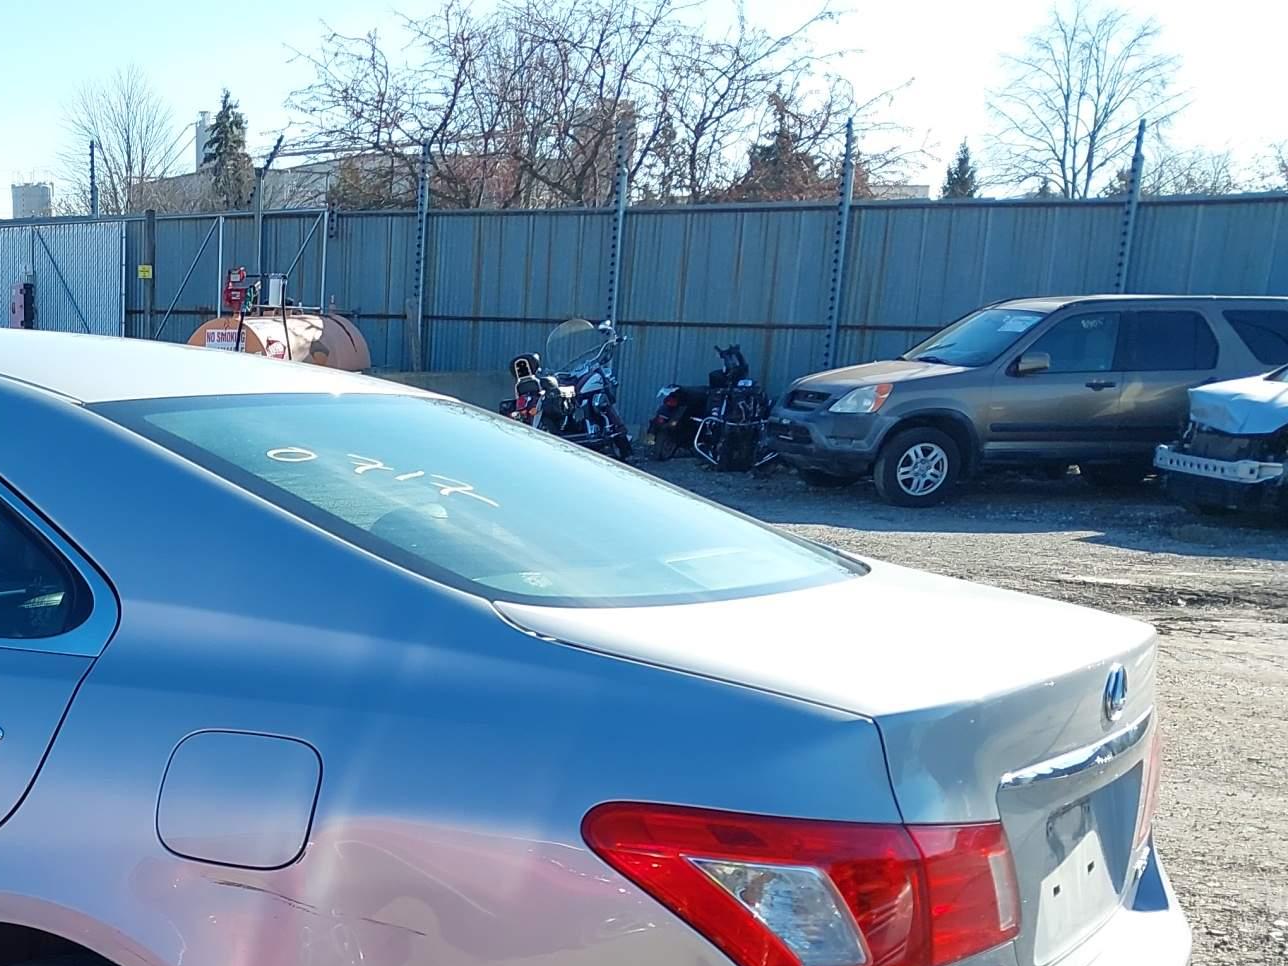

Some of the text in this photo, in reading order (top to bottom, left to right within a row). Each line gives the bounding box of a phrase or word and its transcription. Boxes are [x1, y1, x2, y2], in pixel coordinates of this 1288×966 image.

[206, 331, 245, 343] NO SMOKIG
[266, 446, 500, 508] 0717
